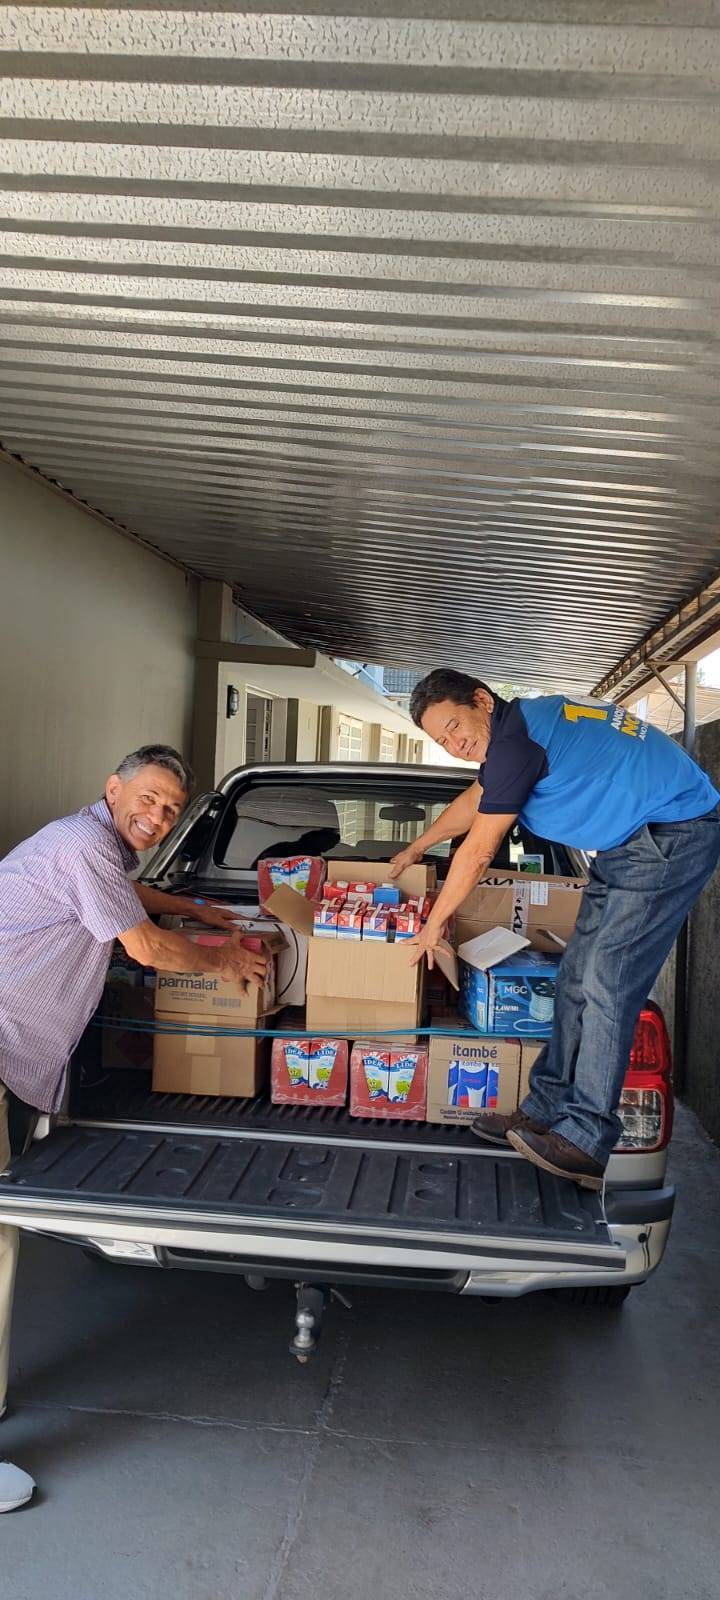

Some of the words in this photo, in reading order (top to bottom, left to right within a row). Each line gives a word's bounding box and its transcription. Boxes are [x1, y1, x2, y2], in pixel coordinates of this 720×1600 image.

[158, 977, 218, 990] parmalat
[504, 985, 528, 994] MGC
[453, 1044, 497, 1058] itambé
